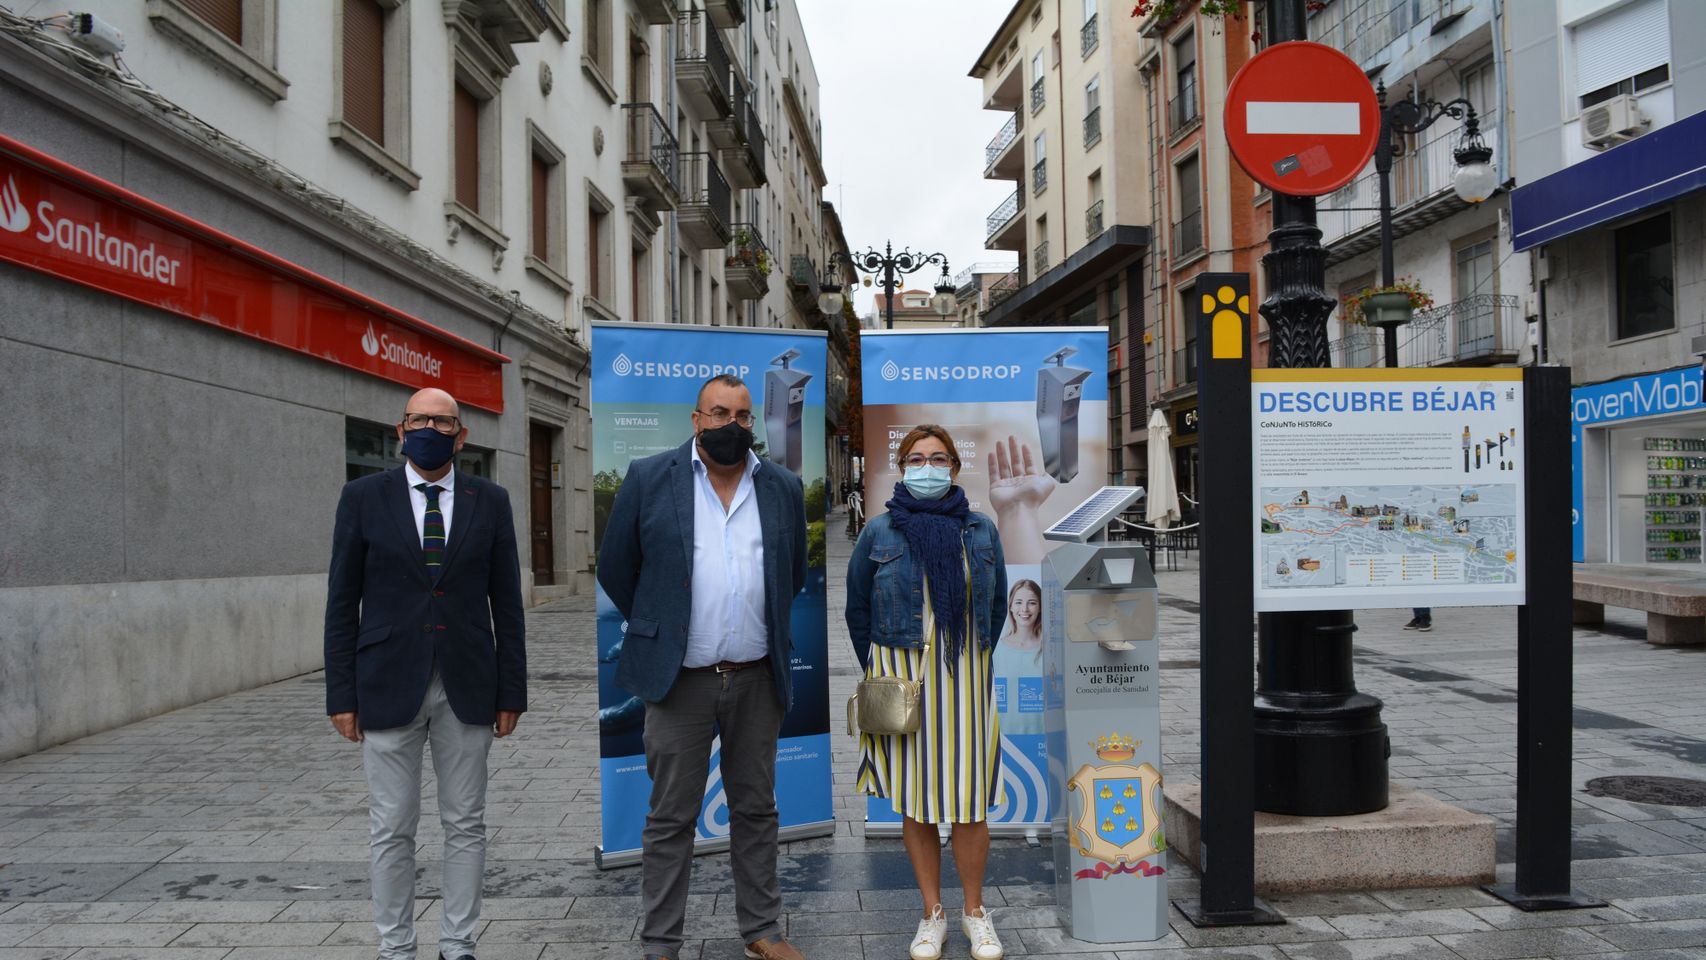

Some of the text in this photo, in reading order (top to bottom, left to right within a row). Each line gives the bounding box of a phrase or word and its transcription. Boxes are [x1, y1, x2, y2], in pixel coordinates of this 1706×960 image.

[36, 200, 181, 286] Santander
[380, 333, 443, 379] Santander
[634, 362, 750, 379] SENSODROP
[901, 365, 1021, 381] SENSODROP
[1260, 391, 1404, 413] DESCUBRE
[1413, 386, 1497, 412] BÉJAR
[1571, 370, 1704, 422] overMobi
[614, 417, 659, 426] VENTAJAS
[1075, 664, 1149, 676] Ayuntamiento
[1090, 674, 1135, 686] de Béjar
[1076, 686, 1111, 695] Concejalía
[1123, 685, 1149, 693] Sanidad
